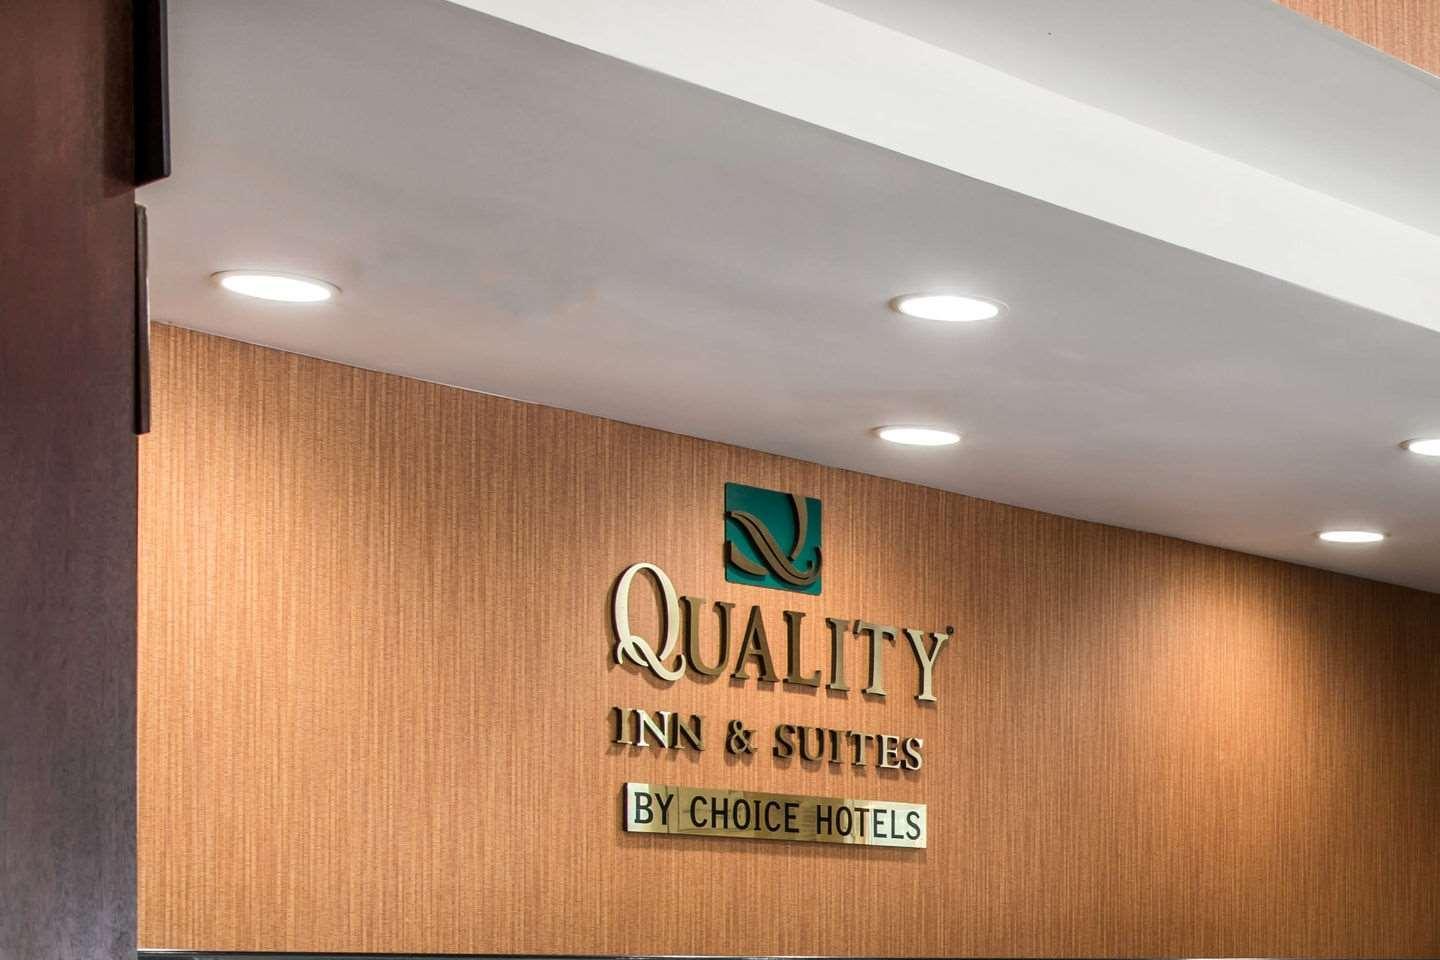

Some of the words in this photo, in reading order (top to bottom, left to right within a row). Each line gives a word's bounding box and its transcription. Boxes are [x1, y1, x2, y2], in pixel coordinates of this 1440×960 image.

[612, 561, 951, 702] QUALITY
[612, 706, 705, 751] INN
[727, 719, 757, 755] &
[773, 724, 924, 771] SUITES
[633, 791, 675, 826] BY
[689, 795, 800, 834] CHOICE
[815, 804, 921, 841] HOTELS
